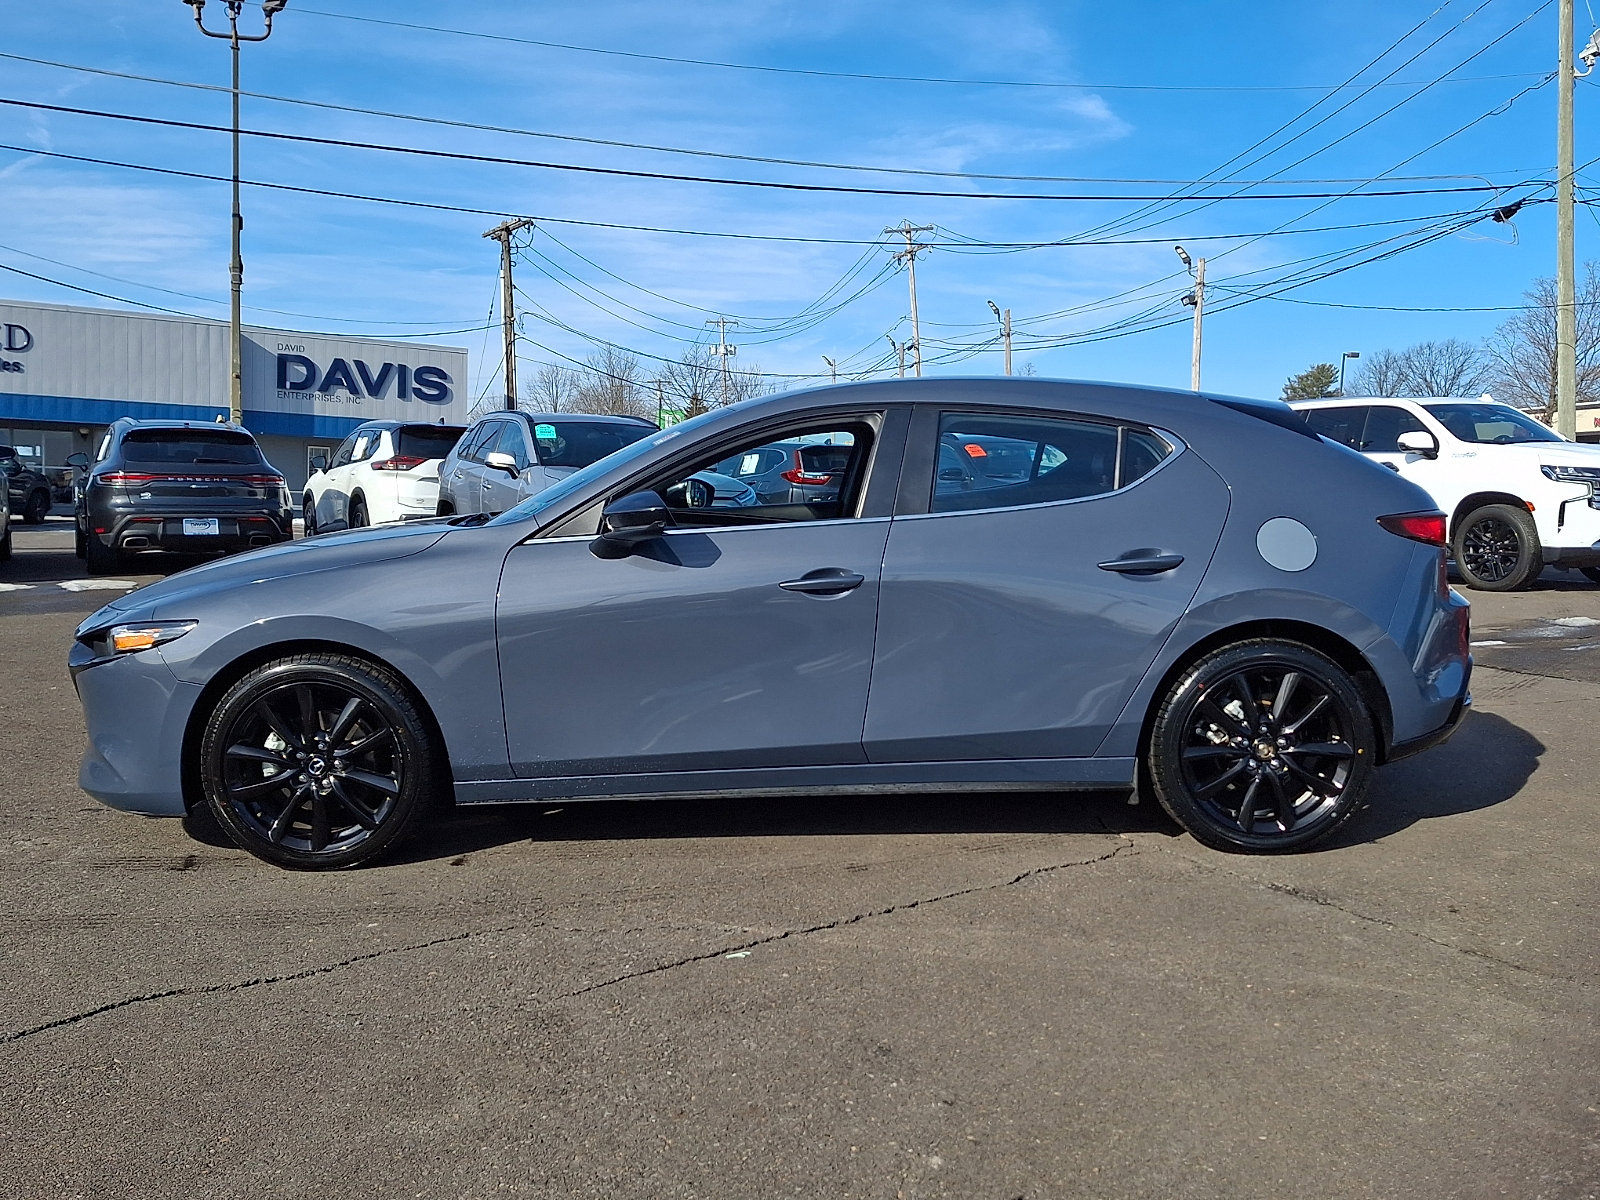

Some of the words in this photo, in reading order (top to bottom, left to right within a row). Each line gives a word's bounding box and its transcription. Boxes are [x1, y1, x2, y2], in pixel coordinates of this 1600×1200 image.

[0, 323, 31, 351] D
[277, 343, 305, 353] DAVID
[1, 360, 25, 372] es
[276, 353, 448, 402] DAVIS
[277, 392, 344, 404] ENTERPRISES,
